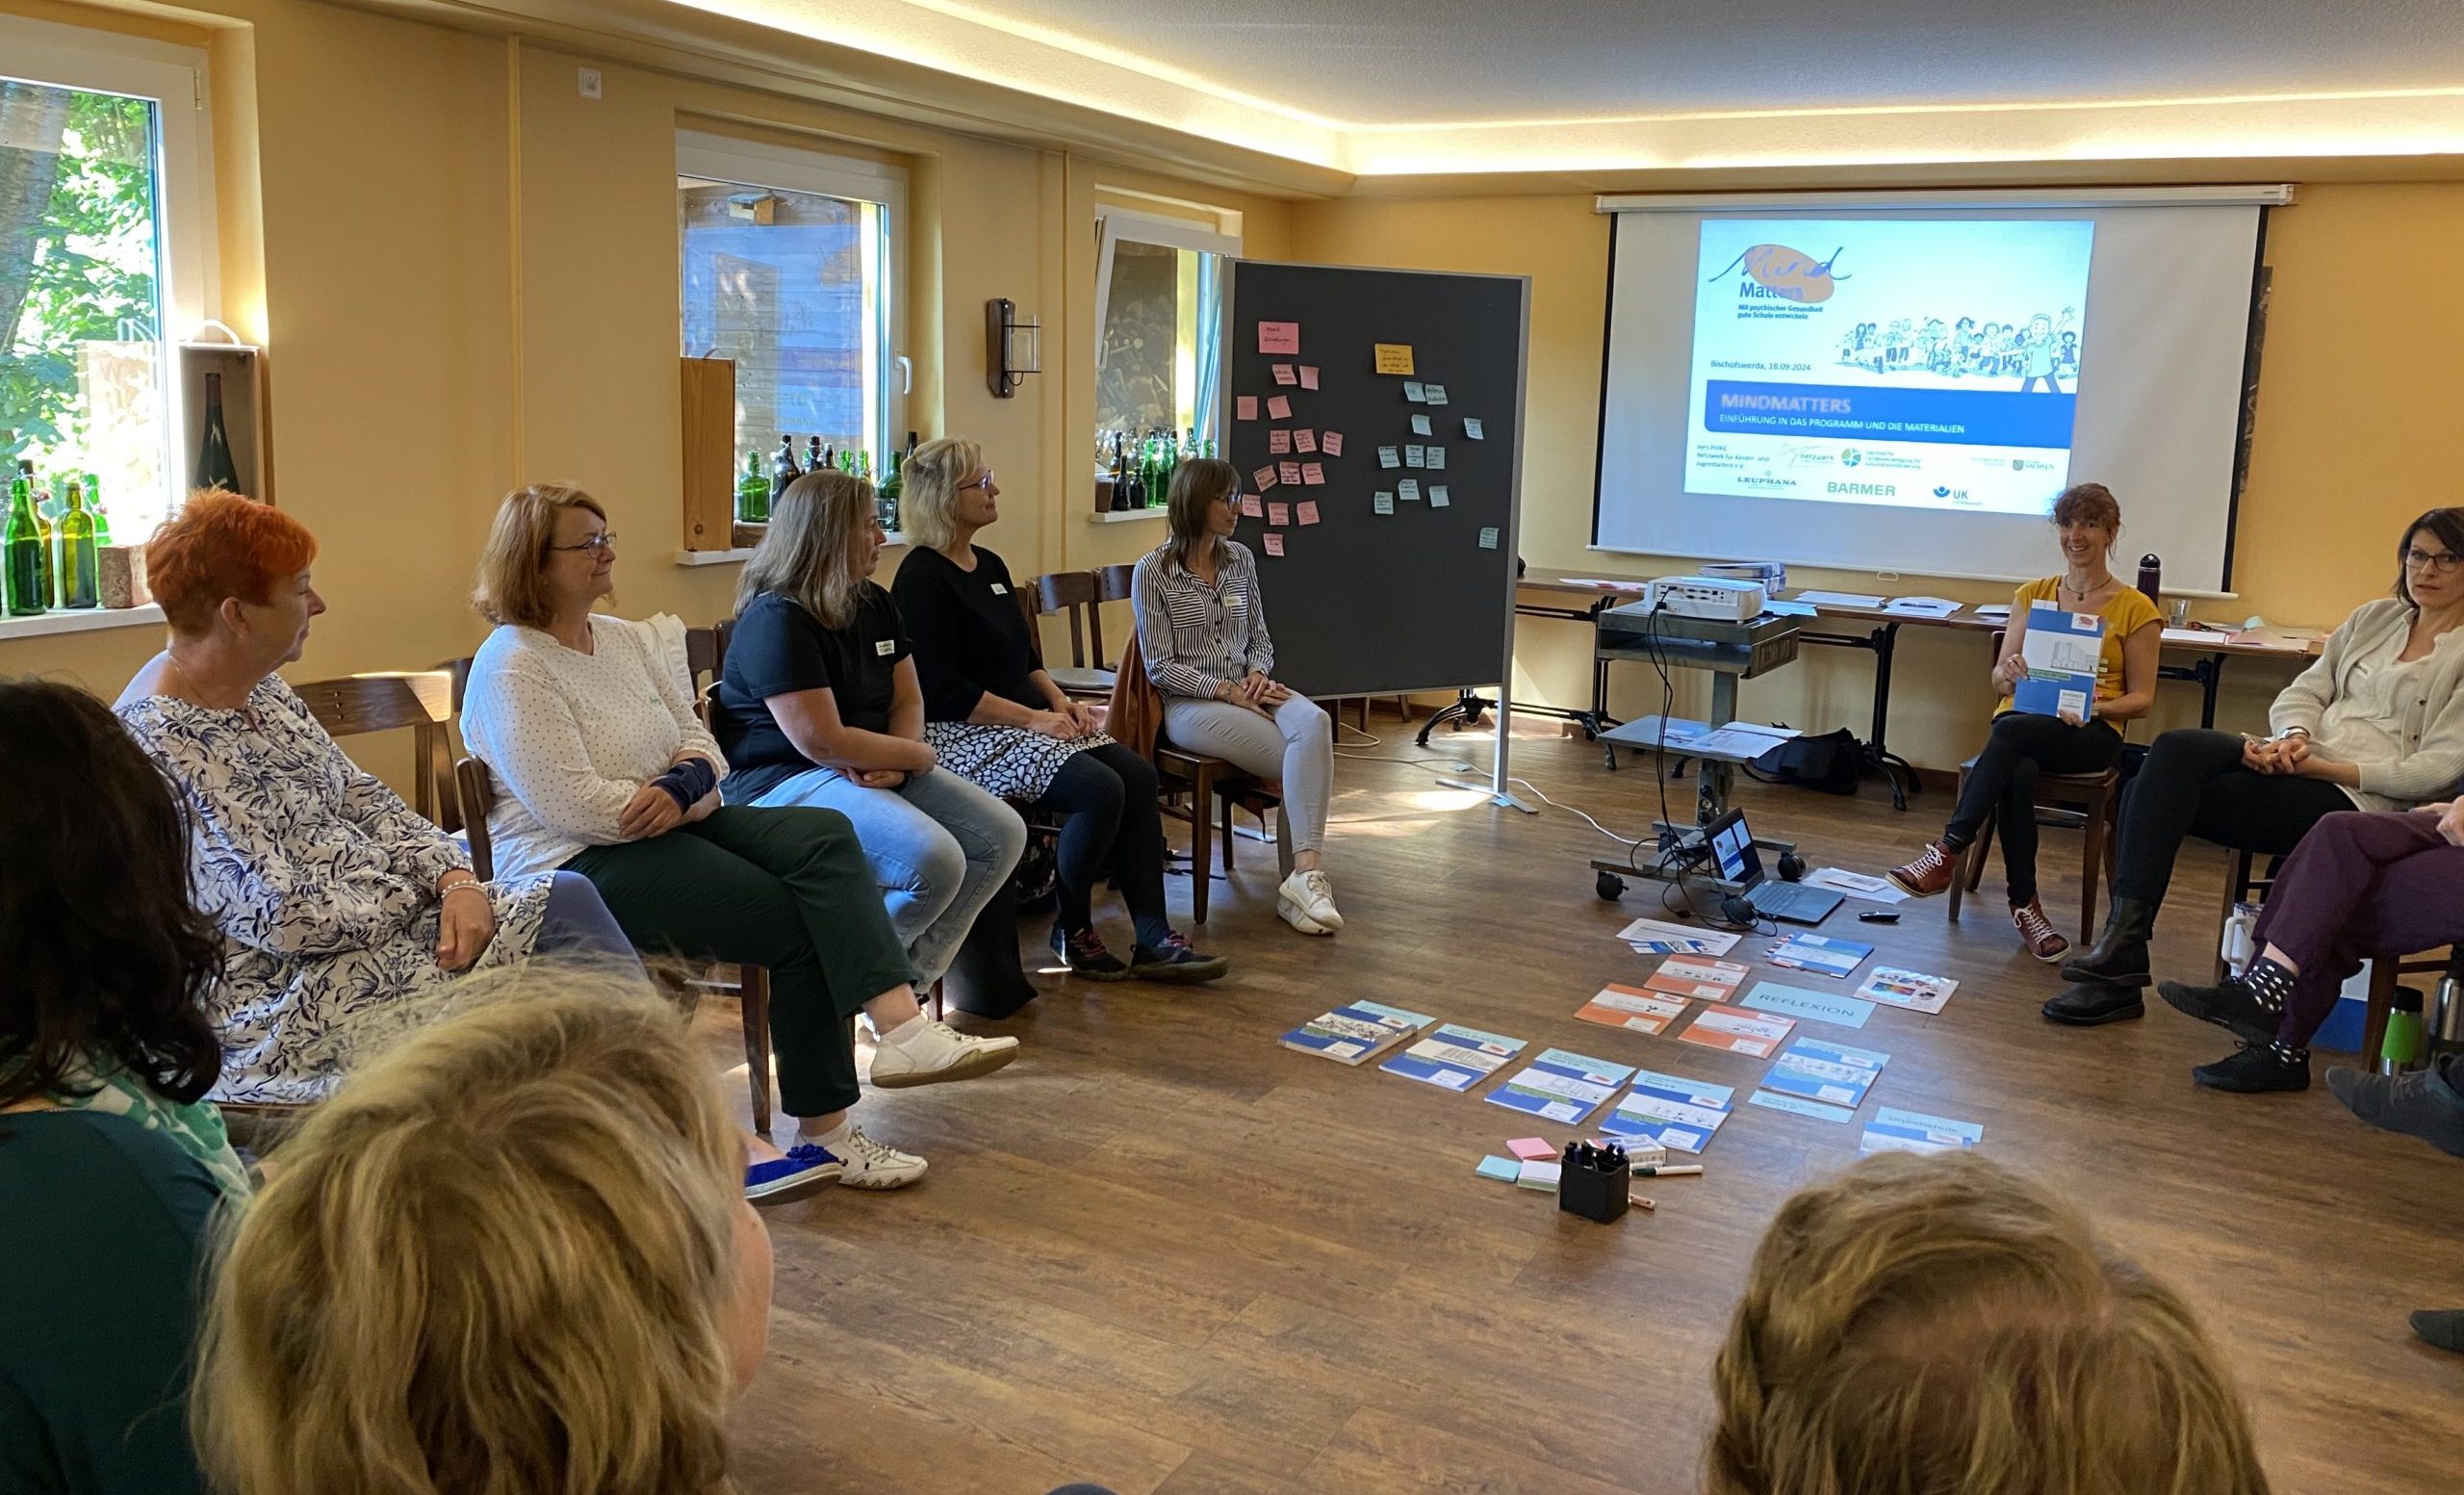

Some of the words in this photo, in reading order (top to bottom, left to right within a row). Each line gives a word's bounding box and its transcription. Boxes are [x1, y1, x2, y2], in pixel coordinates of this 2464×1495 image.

[1739, 281, 1805, 300] Matters
[1787, 304, 1824, 313] Gesundheit
[1710, 360, 1767, 371] Bischofswerda,
[1768, 362, 1811, 372] 18.09.2024
[1721, 393, 1852, 414] MINDMATTERS
[1719, 413, 1777, 425] EINFÜHRUNG
[1778, 417, 1788, 425] IN
[1789, 417, 1808, 426] DAS
[1809, 418, 1863, 429] PROGRAMM
[1865, 421, 1886, 430] UND
[1887, 422, 1903, 431] DIE
[1904, 423, 1965, 433] MATERIALIEN
[1737, 477, 1798, 486] LEUPHANA
[1827, 481, 1896, 497] BARMER
[1953, 489, 1969, 500] UK
[1758, 993, 1856, 1018] REFLEXION
